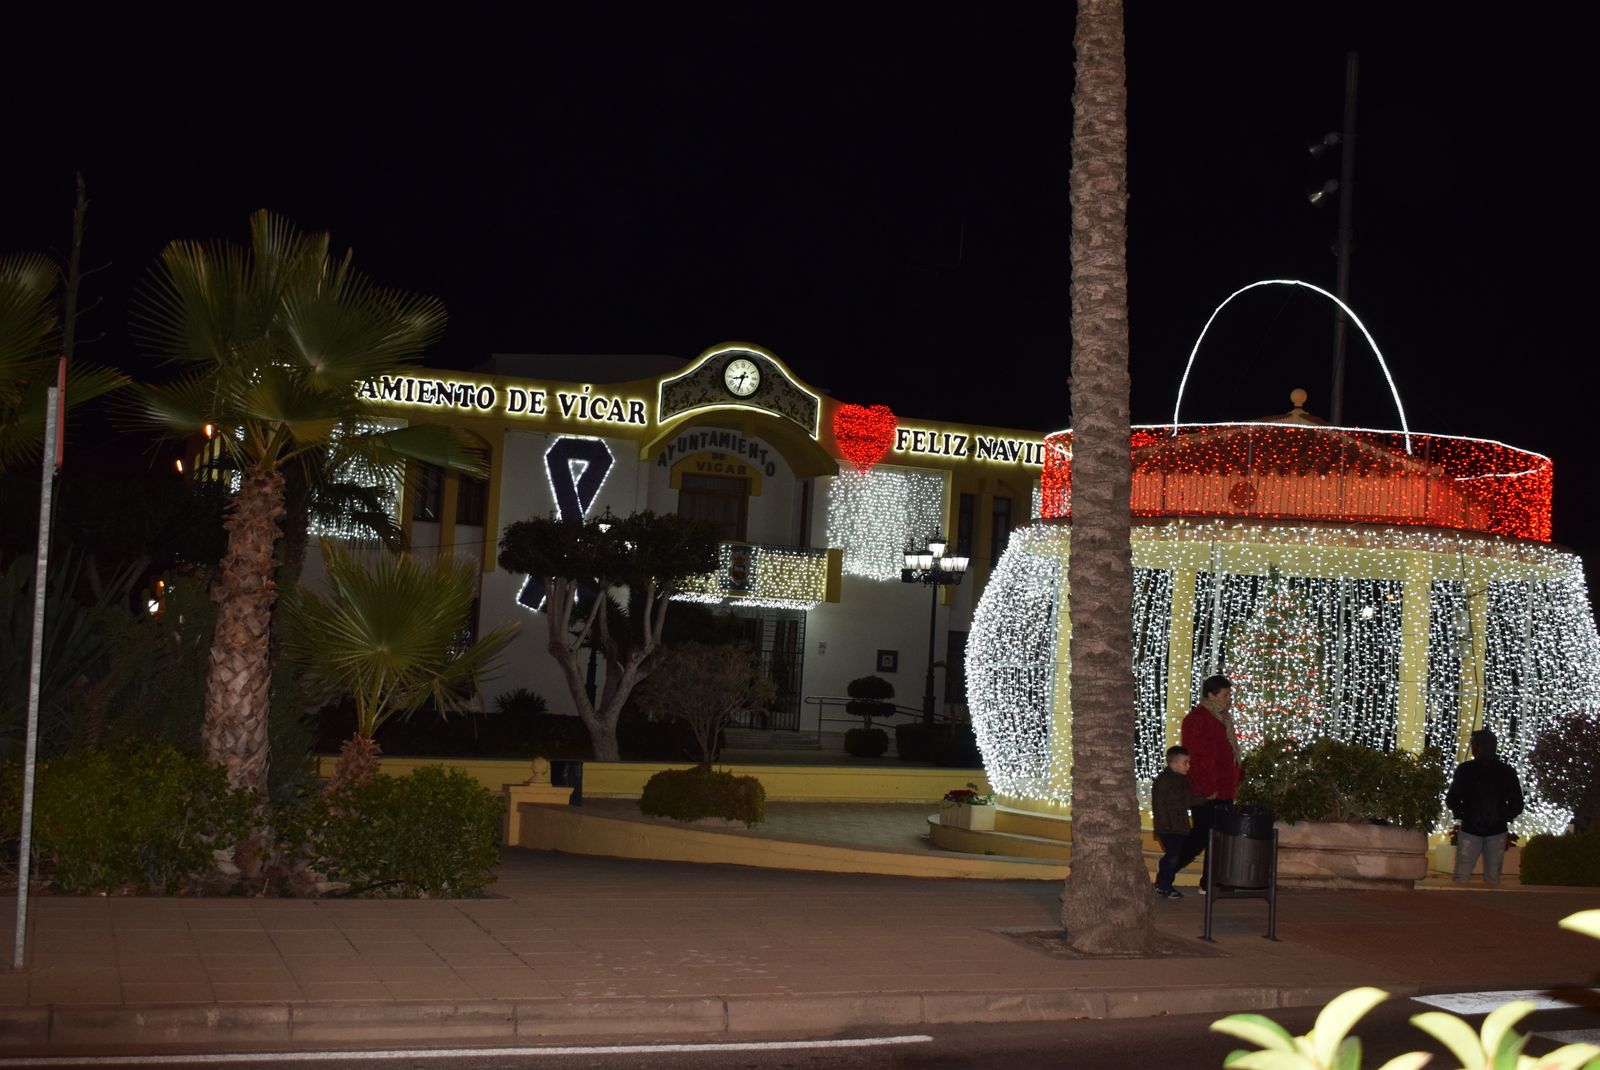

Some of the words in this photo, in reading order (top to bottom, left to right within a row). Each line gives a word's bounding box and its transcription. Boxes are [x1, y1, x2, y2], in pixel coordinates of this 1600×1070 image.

[357, 375, 494, 408] AMIENTO
[508, 388, 546, 415] DE
[558, 384, 646, 424] VÍCAR
[657, 430, 776, 477] AYUNTAMIENTO
[896, 428, 968, 456] FELIZ
[696, 461, 747, 476] VICAR
